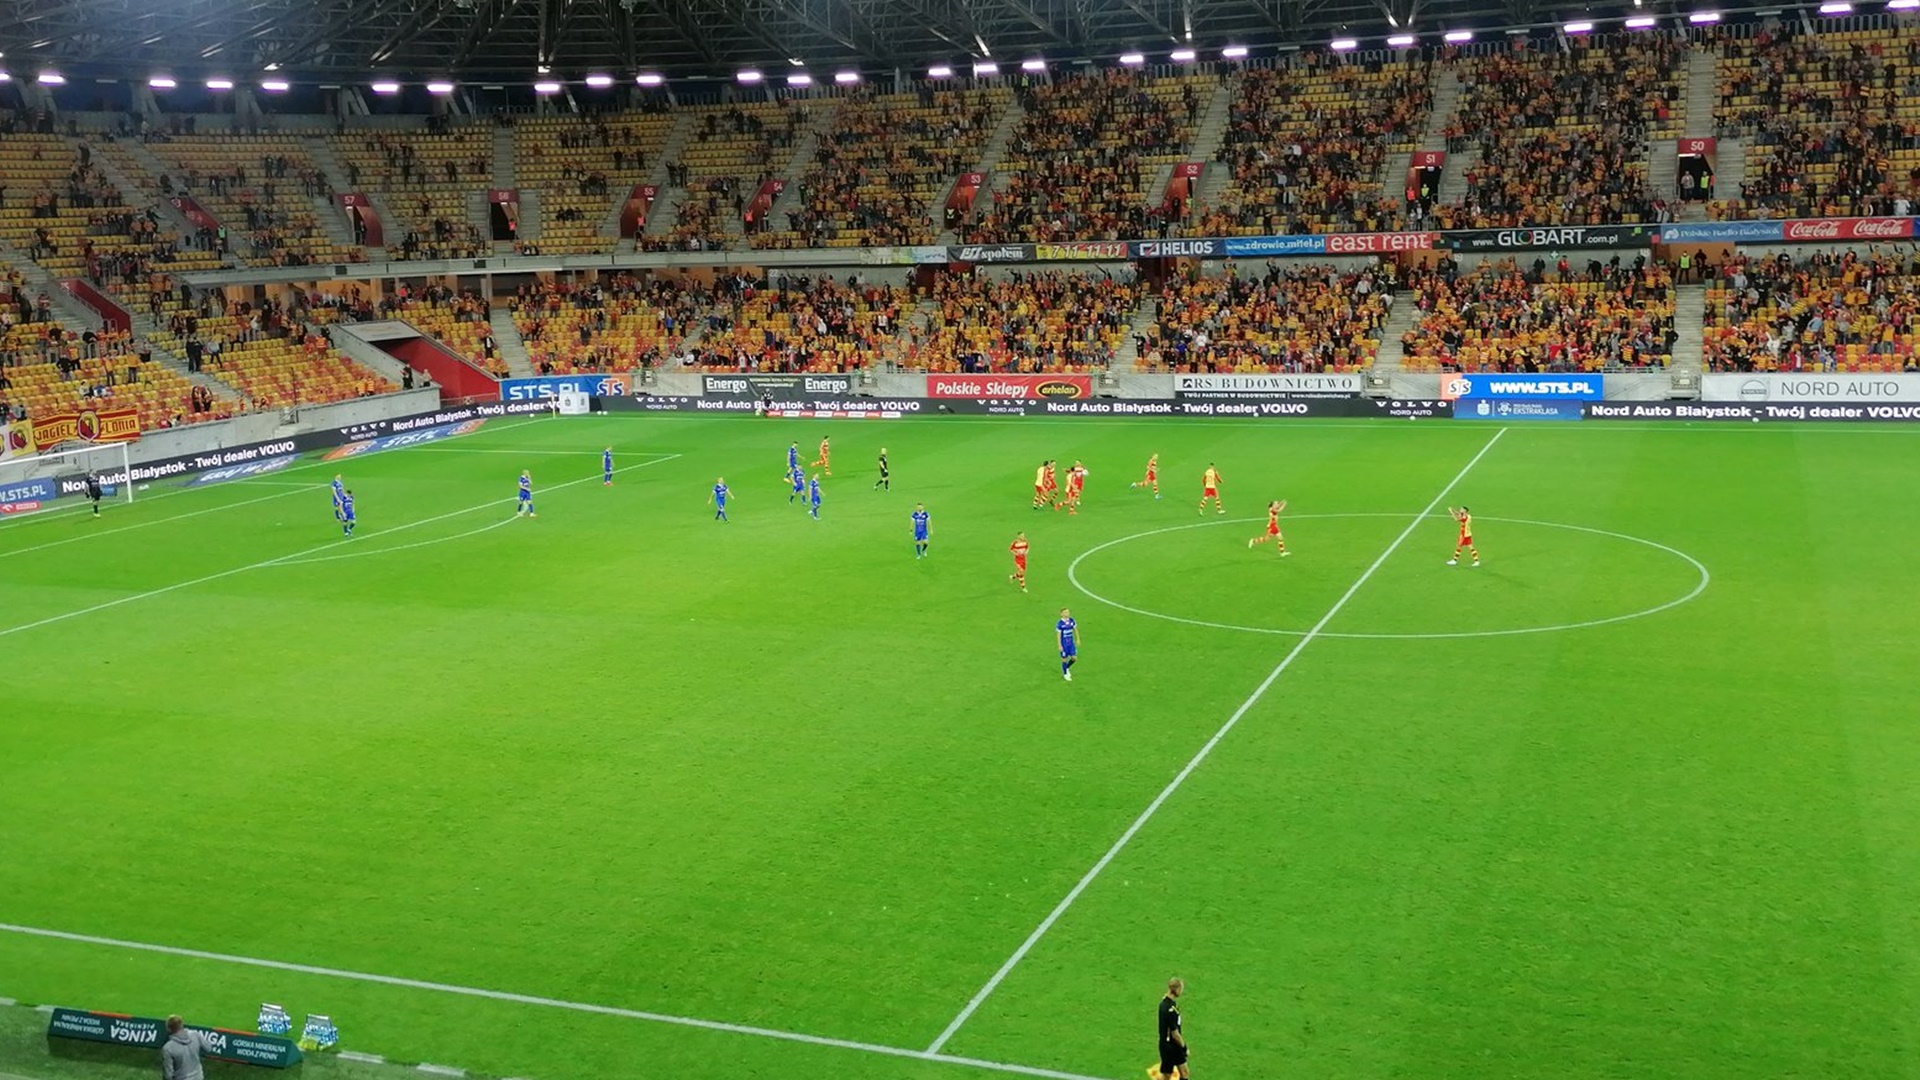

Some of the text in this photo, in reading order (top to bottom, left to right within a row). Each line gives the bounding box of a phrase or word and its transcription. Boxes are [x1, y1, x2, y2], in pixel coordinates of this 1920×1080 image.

[1690, 140, 1705, 151] 50
[1425, 153, 1437, 164] 51
[1186, 164, 1198, 175] 52
[970, 173, 982, 184] 53
[1161, 241, 1214, 255] HELIOS
[1330, 231, 1429, 252] east rent
[706, 377, 747, 394] Energo
[805, 377, 848, 394] Energo
[936, 381, 1029, 398] Polskie Sklepy
[1221, 377, 1353, 389] BUDOWNICTWO
[1489, 381, 1595, 395] WWW.STS.PL
[1781, 381, 1840, 397] NORD
[1846, 381, 1900, 396] AUTO
[697, 399, 725, 409] Nord
[726, 400, 751, 410] Auto
[814, 400, 840, 411] Twój
[842, 400, 878, 410] dealer
[880, 401, 920, 411] VOLVO
[1047, 402, 1078, 412] Nord
[1079, 402, 1110, 412] Auto
[1113, 402, 1172, 414] Białystok
[1182, 402, 1214, 414] Twój
[1216, 402, 1258, 413] dealer
[1260, 403, 1308, 414] VOLVO
[1375, 400, 1447, 408] VOLVO
[1513, 407, 1559, 415] EKSTRAKLASA
[392, 421, 414, 432] Nord
[414, 417, 434, 427] Auto
[435, 408, 472, 425] Białystok
[476, 405, 505, 417] Twój
[507, 402, 546, 413] dealer
[1591, 405, 1631, 417] Nord
[1633, 405, 1673, 417] Auto
[1675, 405, 1752, 420] Białystok
[1766, 405, 1806, 420] Twój
[1809, 406, 1863, 418] dealer
[340, 421, 387, 435] VOLVO
[62, 480, 89, 493] Nor
[98, 472, 128, 486] Auto
[130, 459, 187, 480] Białystok
[195, 453, 222, 468] Twój
[223, 448, 258, 463] dealer
[258, 440, 295, 456] VOLVO
[110, 1024, 158, 1043] KINGA
[202, 1028, 227, 1049] NGA
